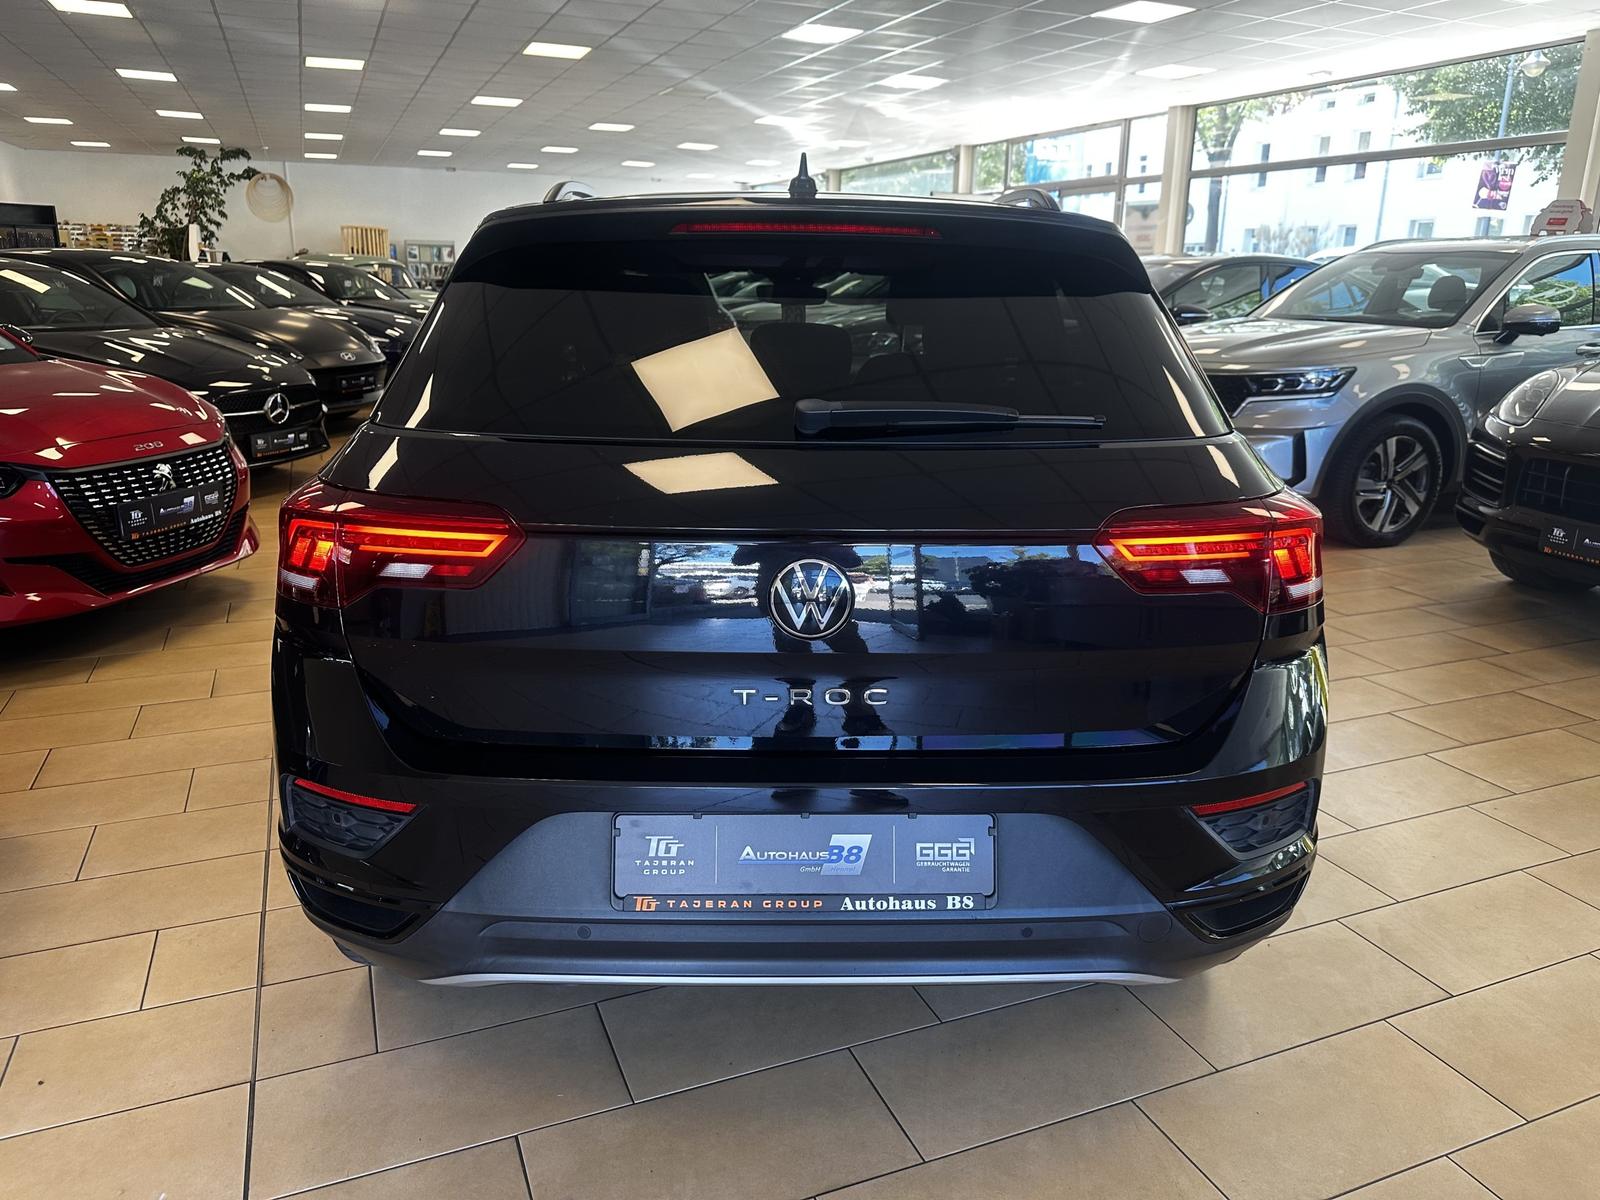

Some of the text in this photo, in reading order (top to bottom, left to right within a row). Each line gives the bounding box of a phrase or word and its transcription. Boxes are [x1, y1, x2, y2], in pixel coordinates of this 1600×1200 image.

[733, 688, 888, 705] T-ROC
[916, 842, 971, 861] GGG
[667, 900, 752, 909] TAJERAN
[762, 900, 823, 909] GROUP
[840, 896, 937, 911] Autohaus
[946, 895, 974, 910] B8
